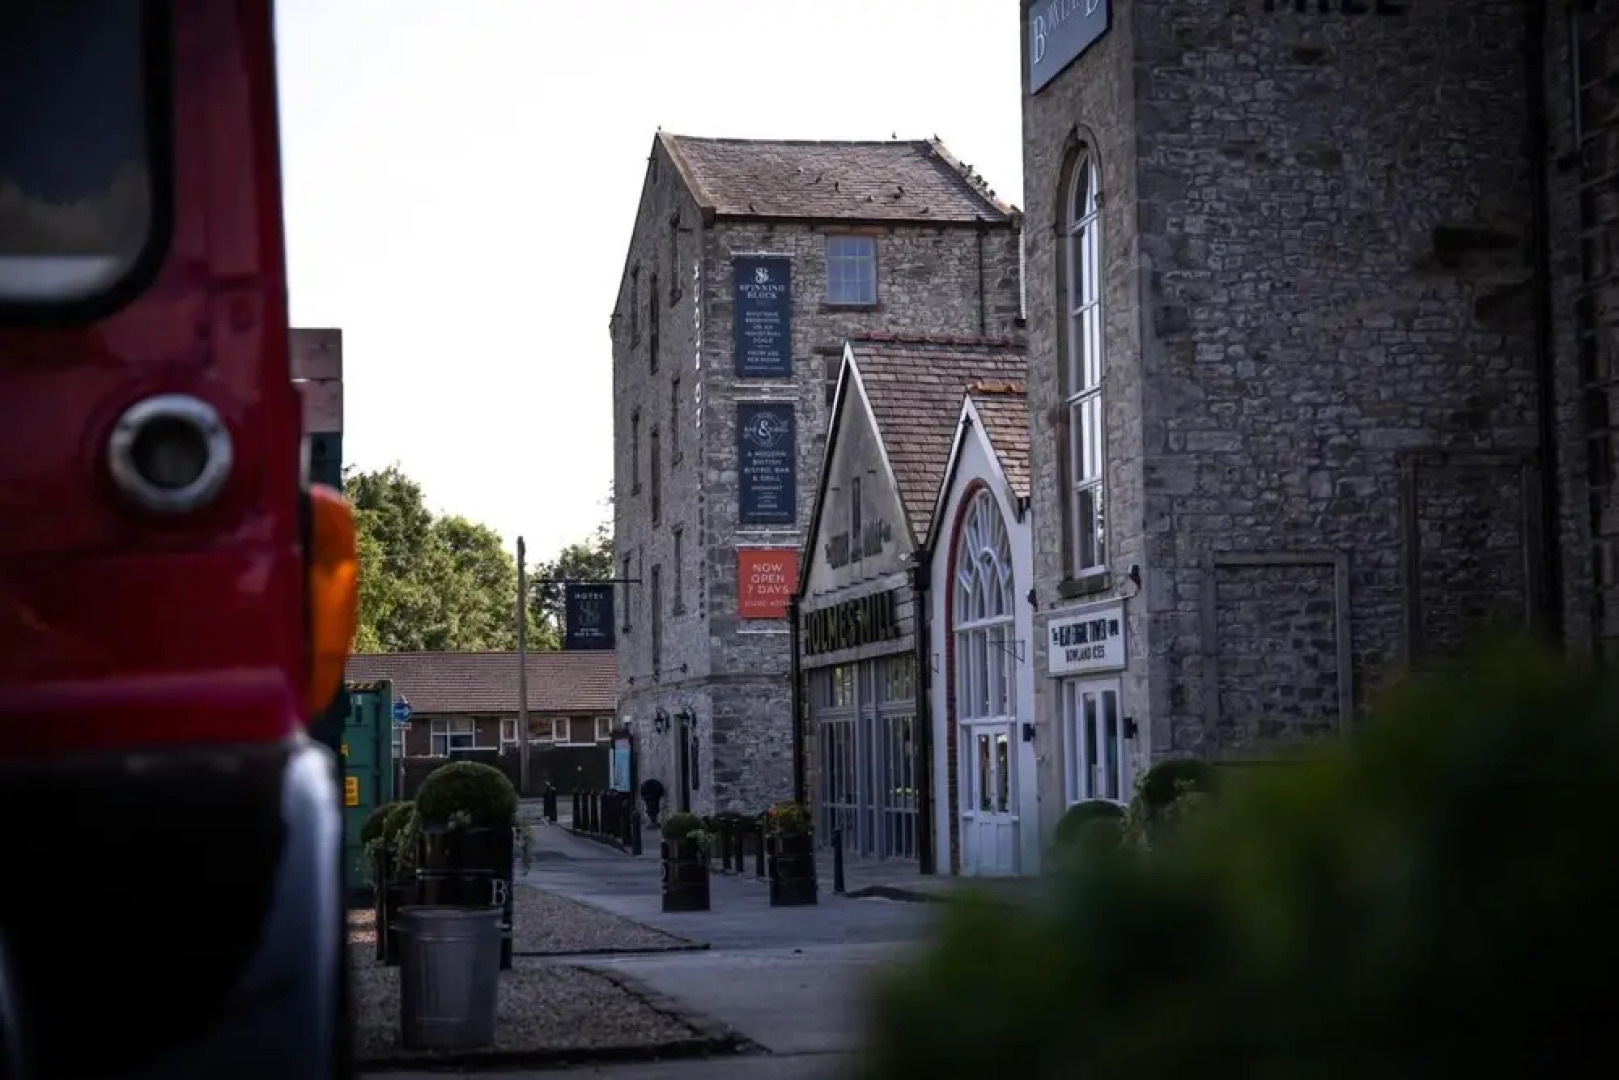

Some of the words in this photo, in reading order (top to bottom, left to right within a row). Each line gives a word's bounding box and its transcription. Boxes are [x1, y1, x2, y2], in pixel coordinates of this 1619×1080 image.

[752, 563, 783, 572] NOW
[750, 574, 784, 584] OPEN
[747, 584, 754, 595] 7
[757, 584, 789, 595] DAYS
[574, 592, 604, 600] HOTEL
[802, 598, 860, 655] HOLMES
[860, 589, 899, 646] MILL
